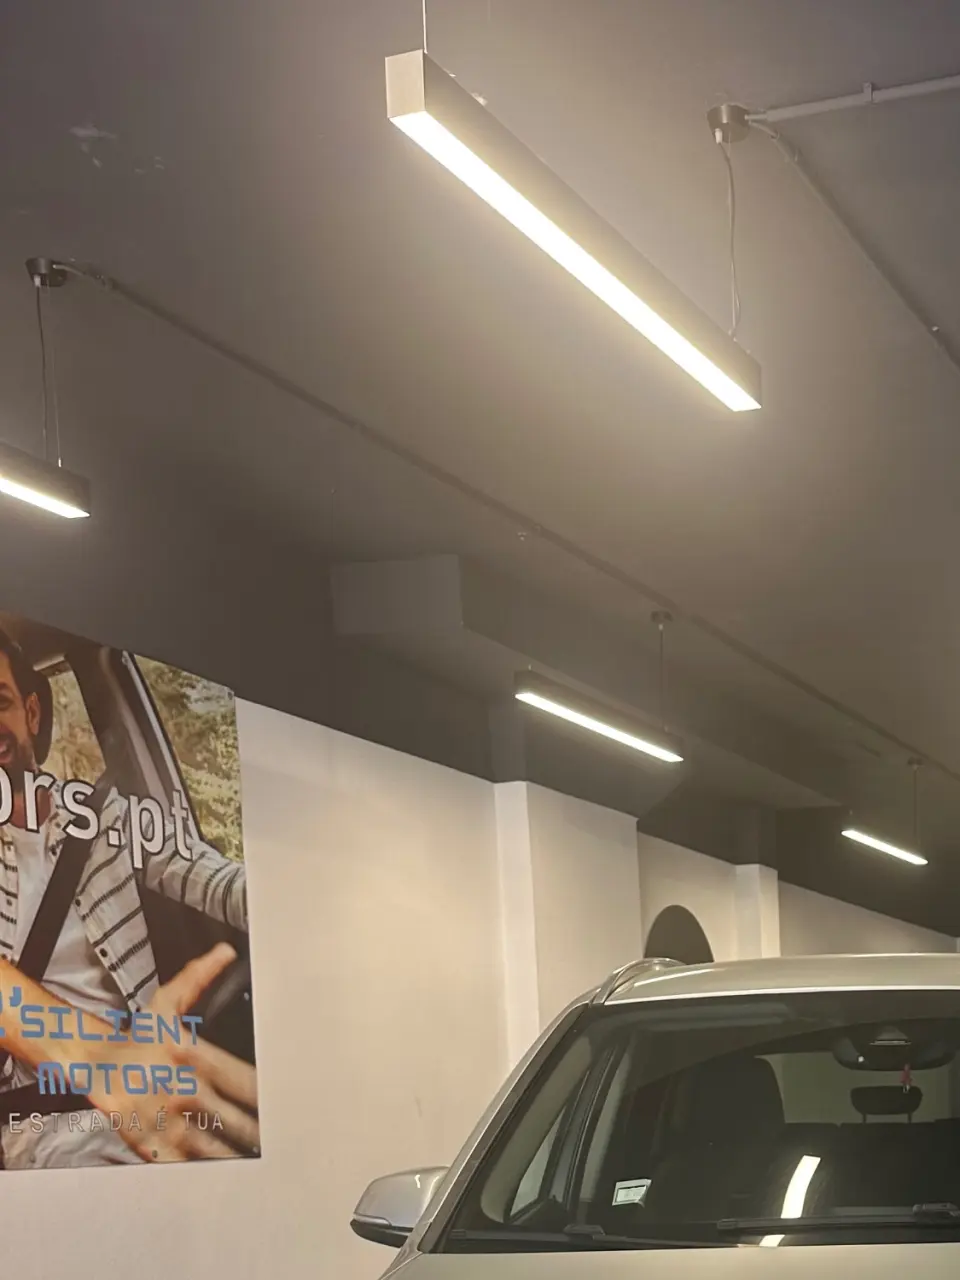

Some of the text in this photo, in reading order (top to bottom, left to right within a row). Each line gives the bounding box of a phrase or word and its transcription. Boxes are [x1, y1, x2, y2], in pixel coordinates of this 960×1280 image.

[0, 986, 203, 1046] 'SILIENT
[37, 1061, 198, 1095] MOTORS
[9, 1105, 224, 1134] ESTRADA É TUA
